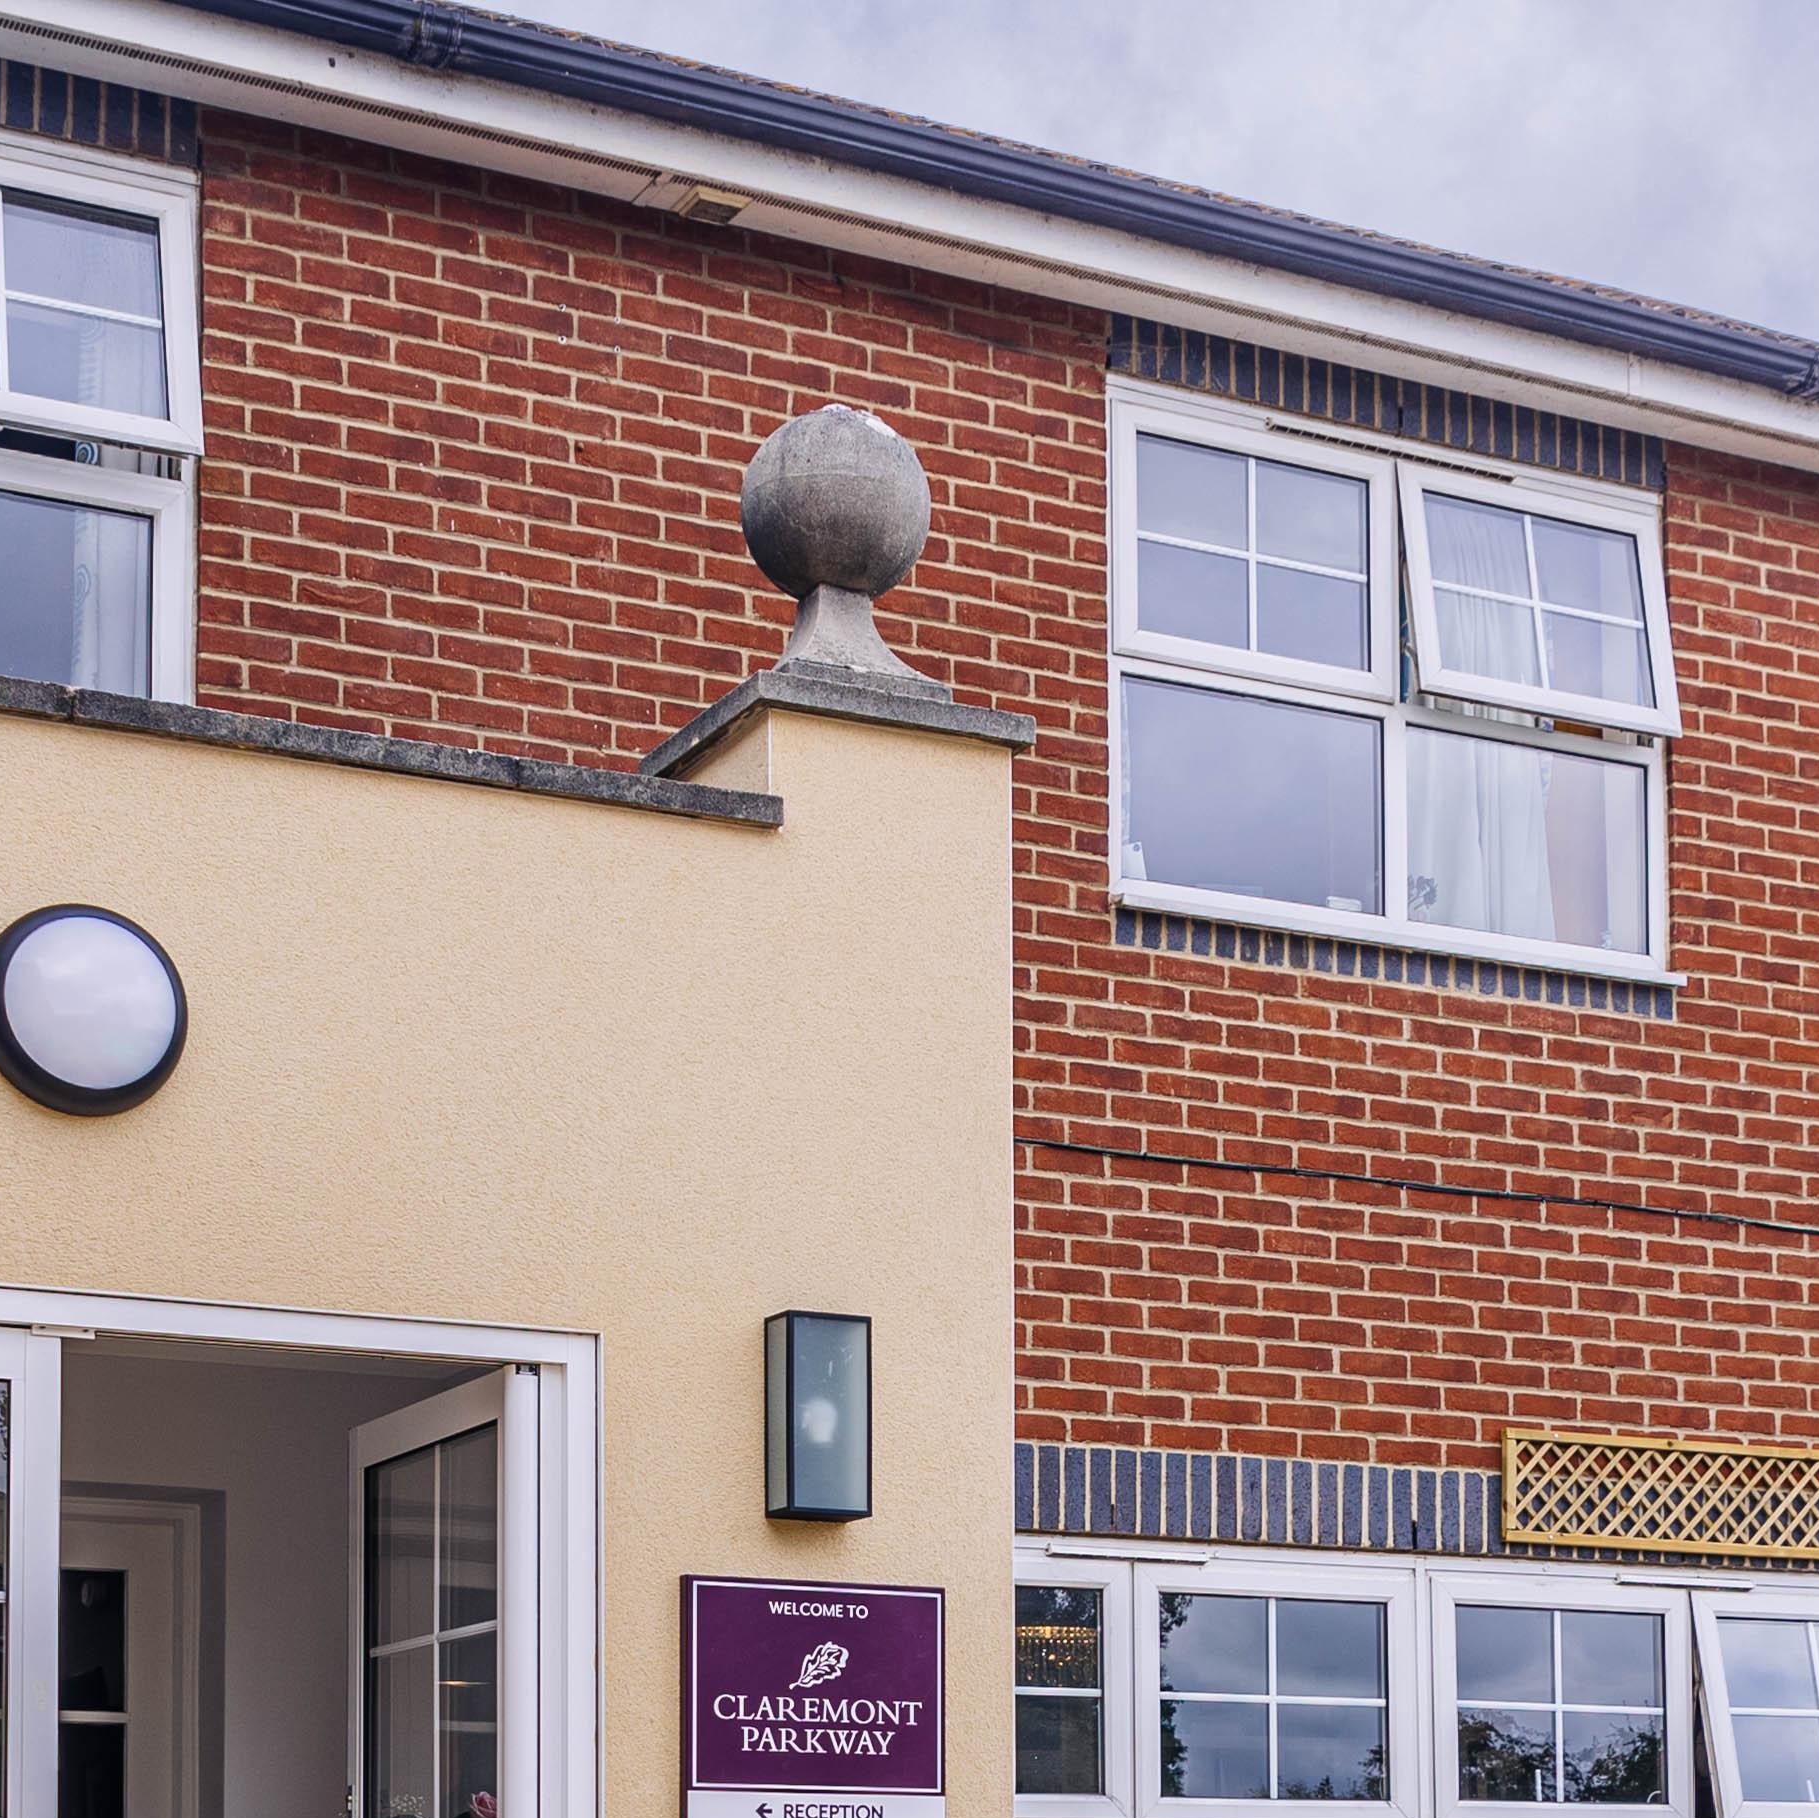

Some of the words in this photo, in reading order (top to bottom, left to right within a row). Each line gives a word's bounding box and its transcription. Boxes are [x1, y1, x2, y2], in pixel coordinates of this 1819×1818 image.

[768, 1600, 844, 1618] WELCOME
[846, 1604, 869, 1619] TO
[713, 1693, 923, 1726] CLAREMONT
[740, 1726, 896, 1756] PARKWAY
